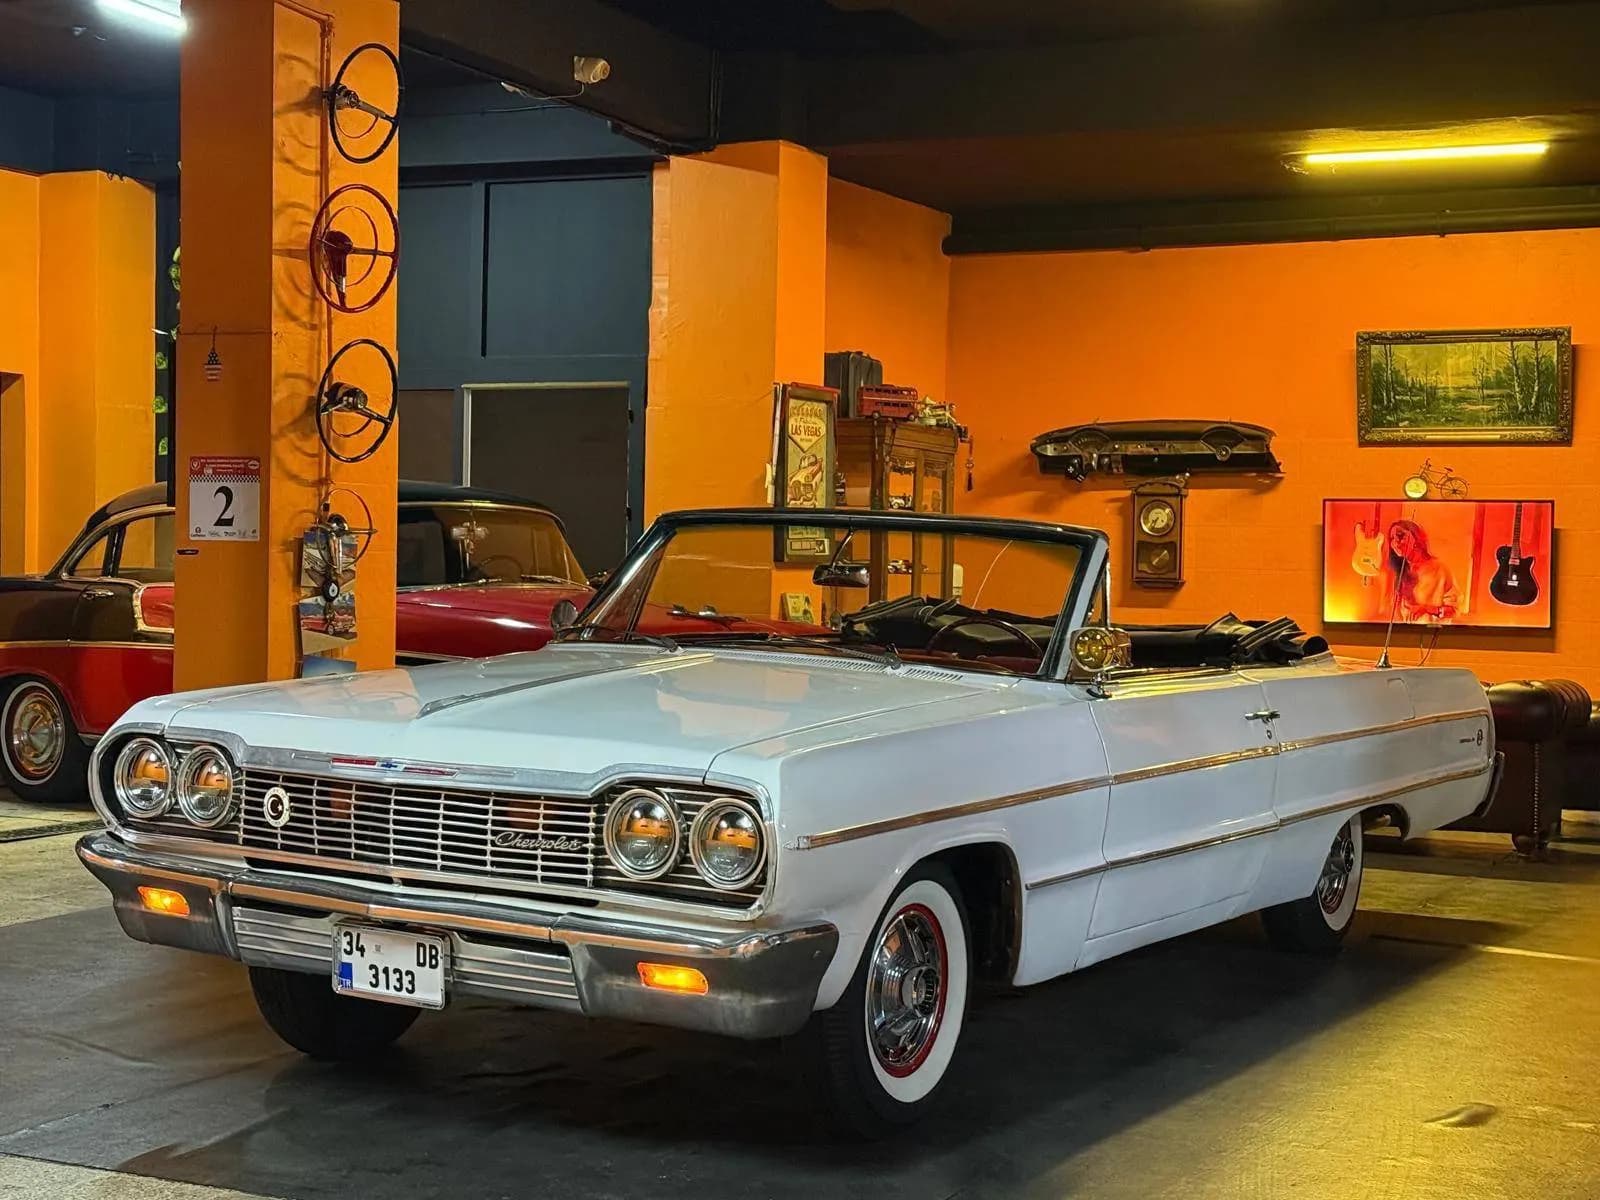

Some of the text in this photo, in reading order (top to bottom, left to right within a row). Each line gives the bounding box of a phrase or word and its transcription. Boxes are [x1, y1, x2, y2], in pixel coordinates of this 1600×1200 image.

[791, 424, 822, 438] LAS VEGAS
[213, 486, 234, 526] 2
[495, 831, 582, 851] Chevrolet
[343, 931, 439, 969] 34 DB
[342, 979, 352, 989] TR
[368, 964, 416, 994] 3133
